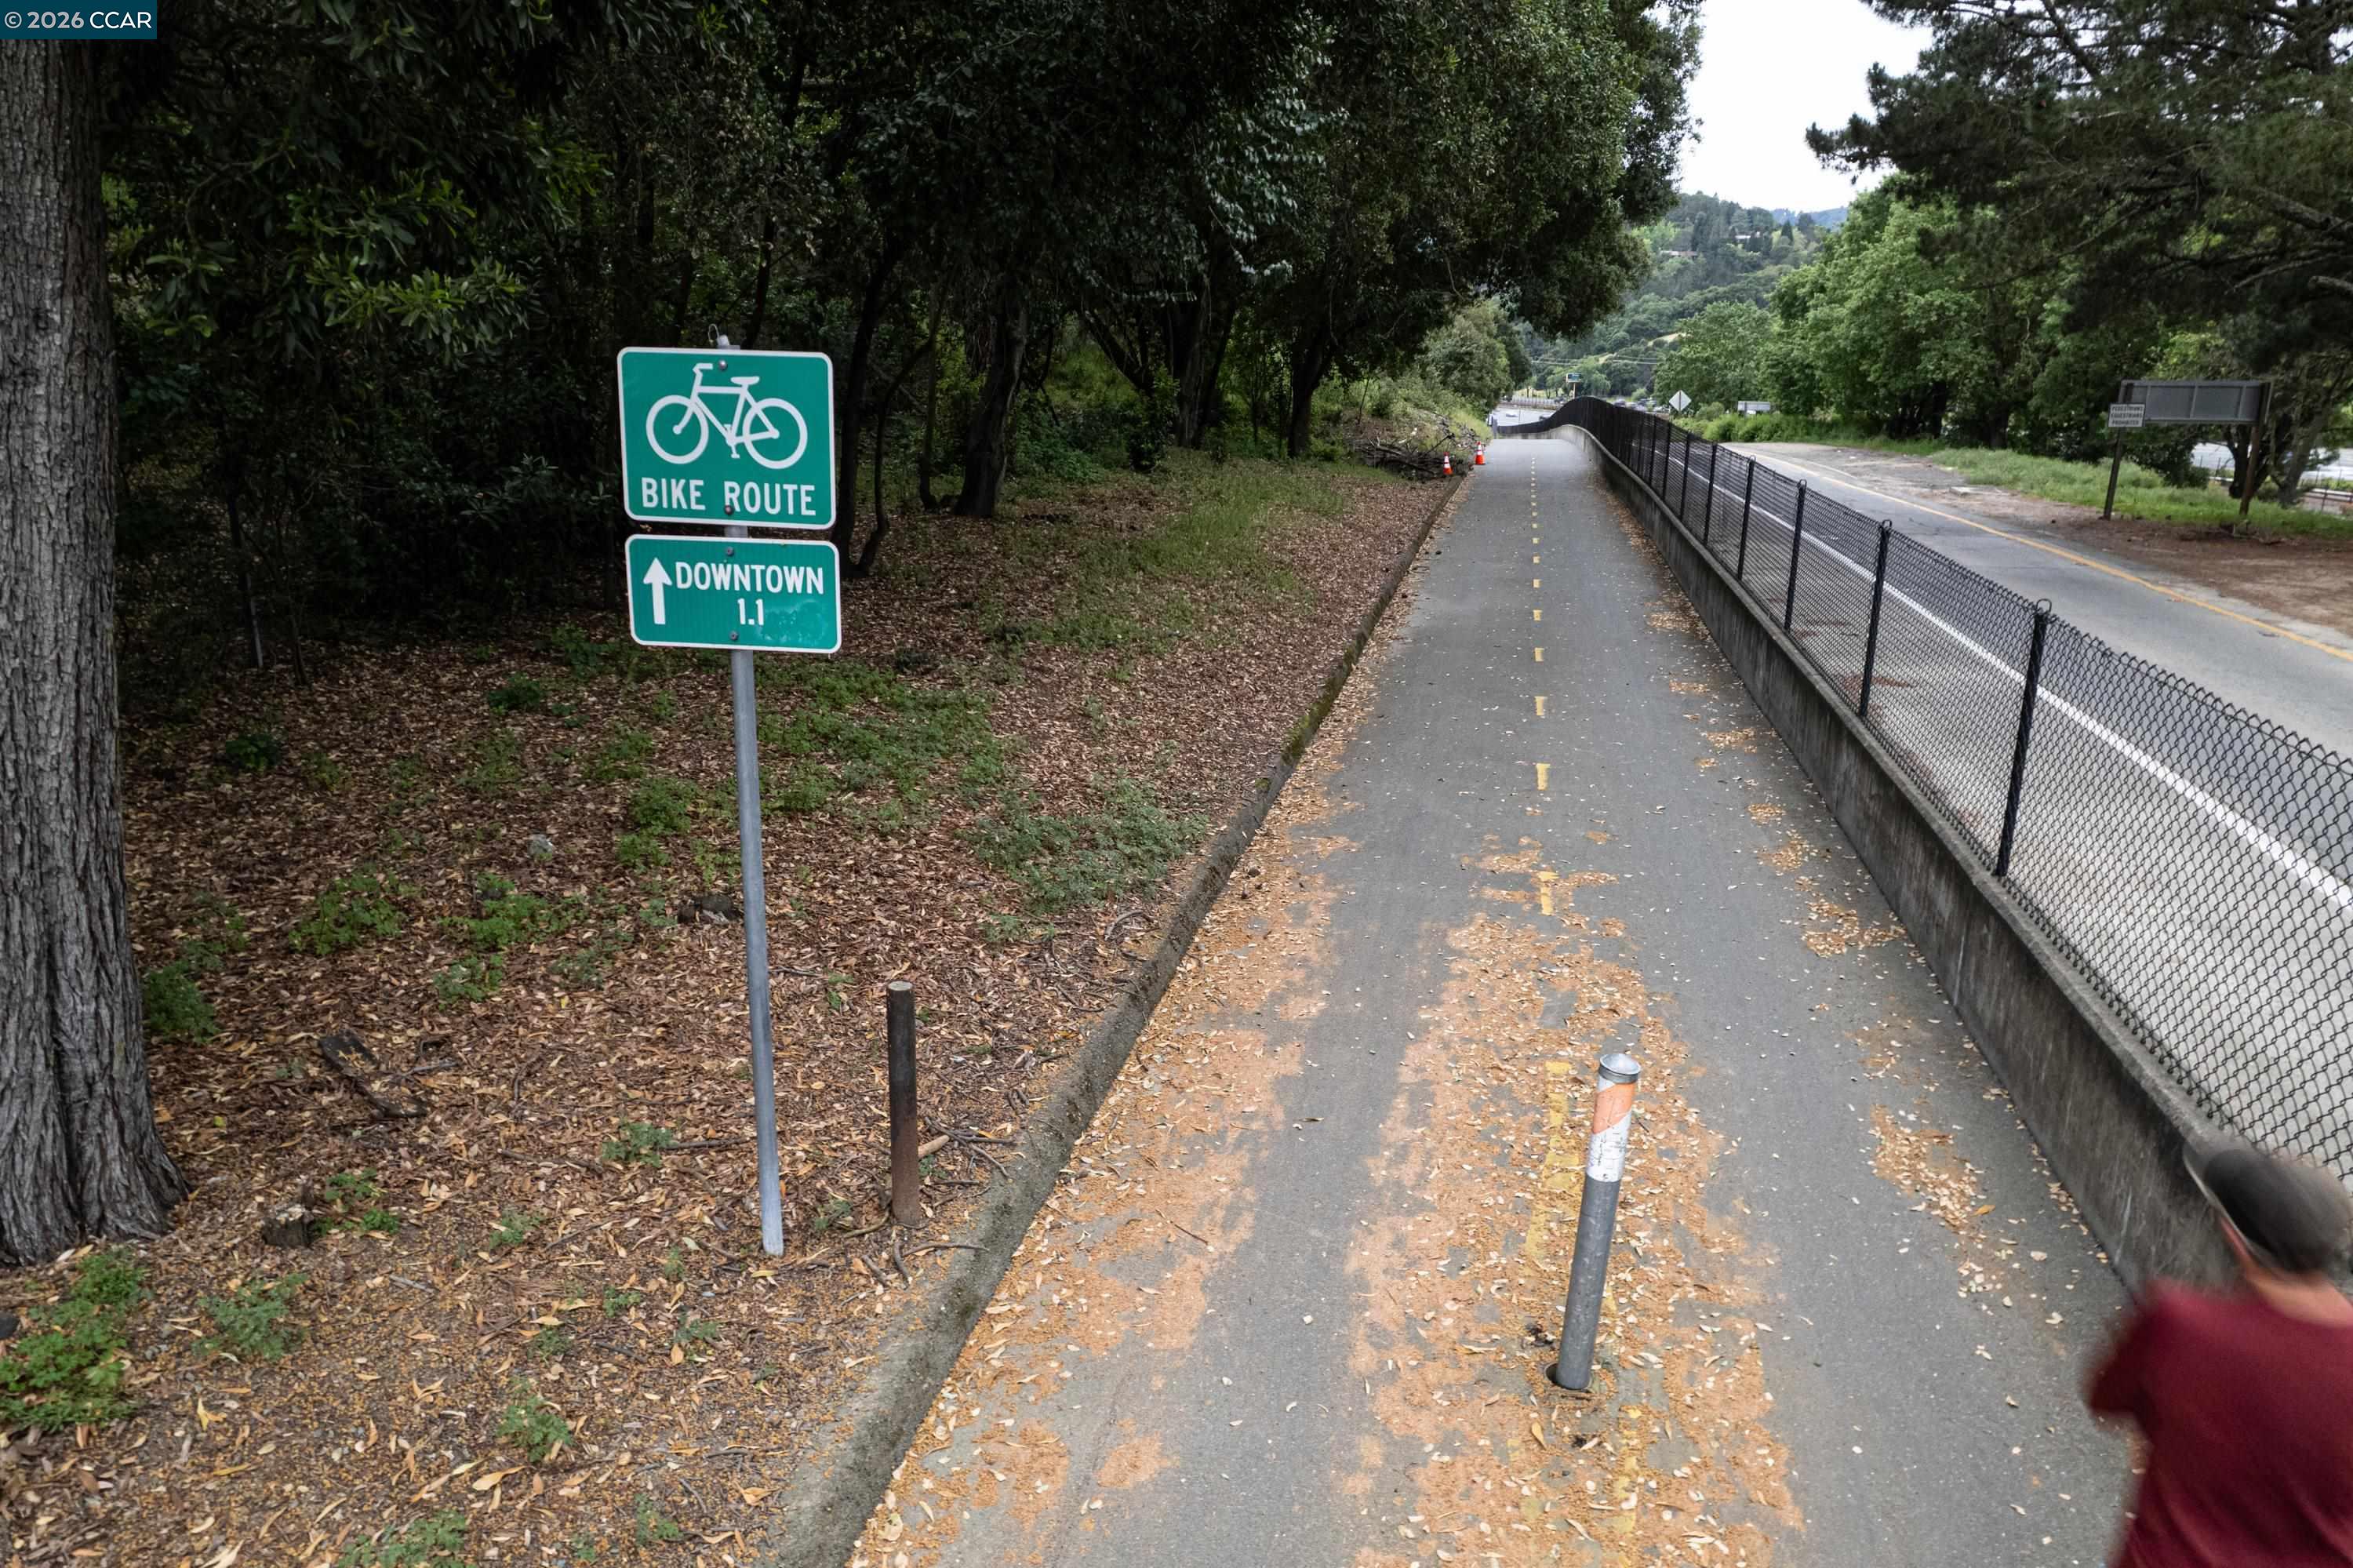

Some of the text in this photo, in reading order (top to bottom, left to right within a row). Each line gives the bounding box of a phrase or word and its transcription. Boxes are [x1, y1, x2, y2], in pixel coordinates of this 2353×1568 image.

[642, 477, 816, 515] BIKE ROUTE
[675, 562, 824, 595] DOWNTOWN
[737, 598, 764, 626] 1.1
